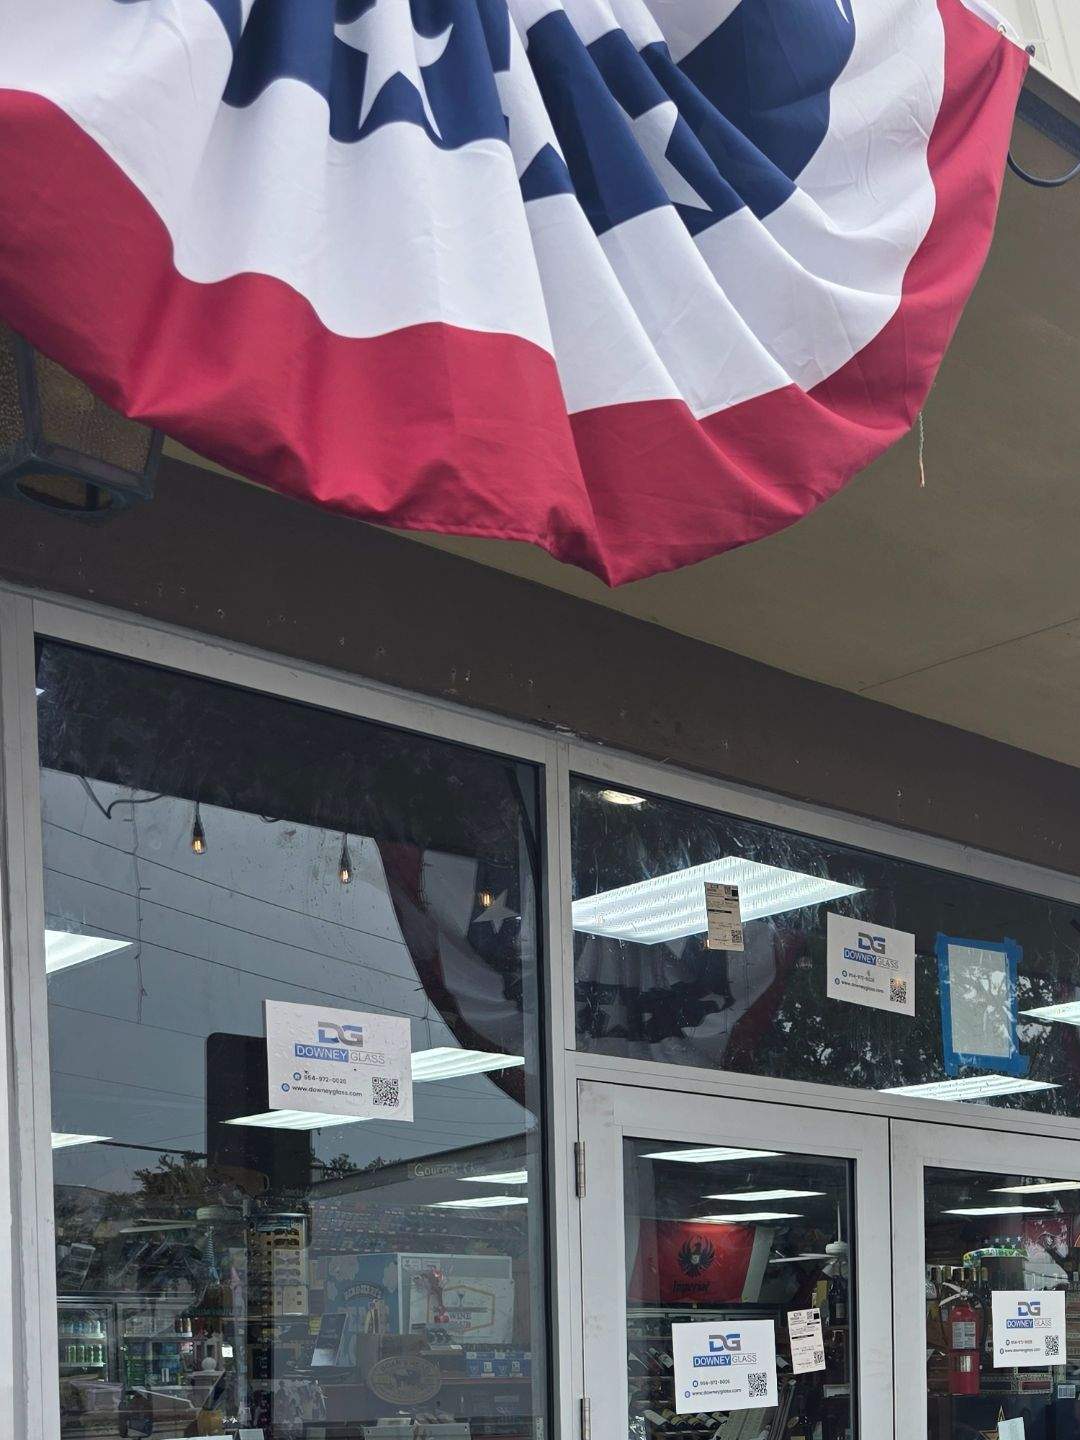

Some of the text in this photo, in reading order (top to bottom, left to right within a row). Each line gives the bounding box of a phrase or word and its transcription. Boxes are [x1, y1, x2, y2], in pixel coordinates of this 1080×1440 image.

[858, 932, 886, 954] DG
[844, 948, 899, 969] DOWNEY GLASS
[318, 1021, 363, 1047] DG
[295, 1044, 386, 1065] DOWNEY GLASS
[292, 1084, 363, 1098] www.downeyglass.com
[1017, 1301, 1041, 1316] DG
[1006, 1319, 1034, 1329] DOWNEY
[708, 1333, 742, 1352] DG
[693, 1354, 758, 1367] DOWNEY GLASS
